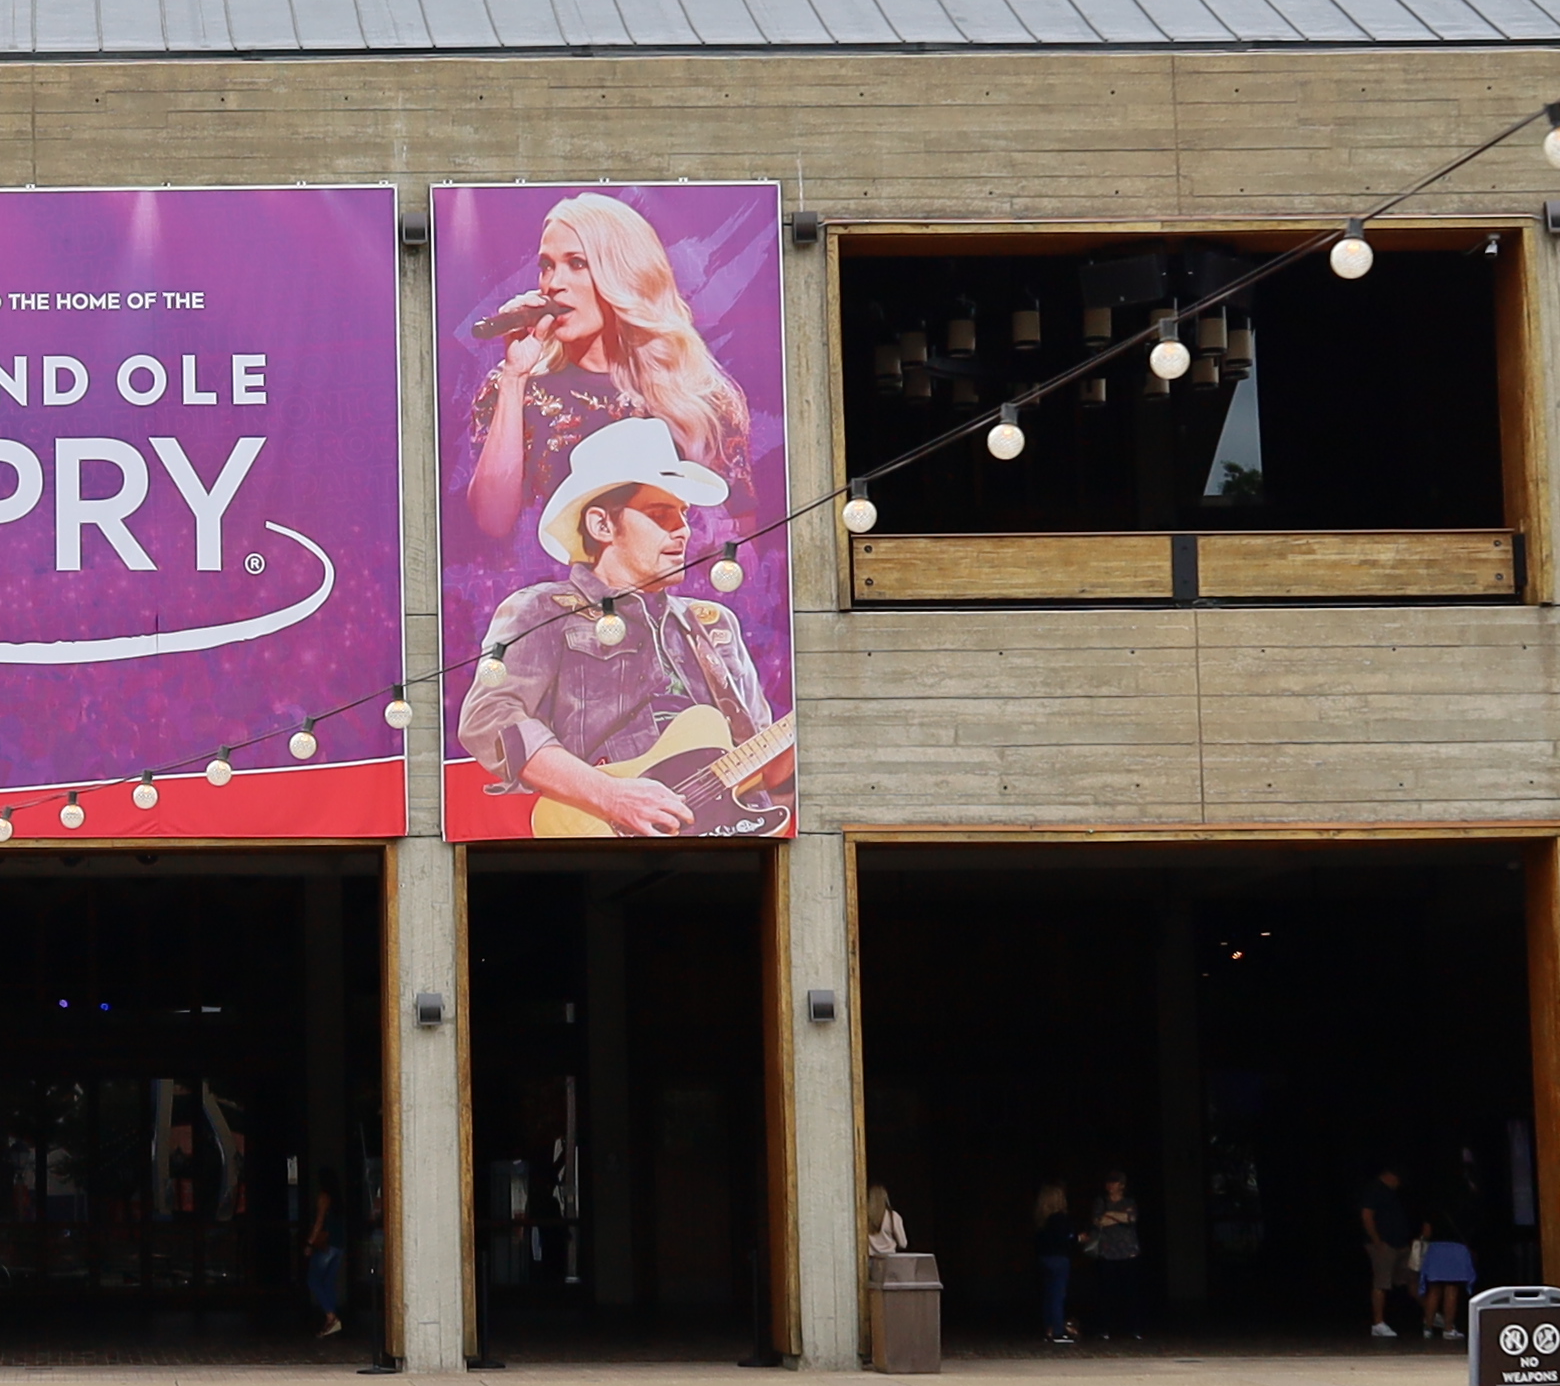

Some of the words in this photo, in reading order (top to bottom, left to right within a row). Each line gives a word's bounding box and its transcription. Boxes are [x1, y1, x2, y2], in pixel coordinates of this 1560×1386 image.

[8, 293, 50, 311] THE
[56, 292, 121, 310] HOME
[127, 292, 156, 310] OF
[162, 291, 205, 310] THE
[116, 353, 268, 407] OLE
[1520, 1356, 1540, 1368] NO
[1502, 1370, 1558, 1383] WEAPONS
